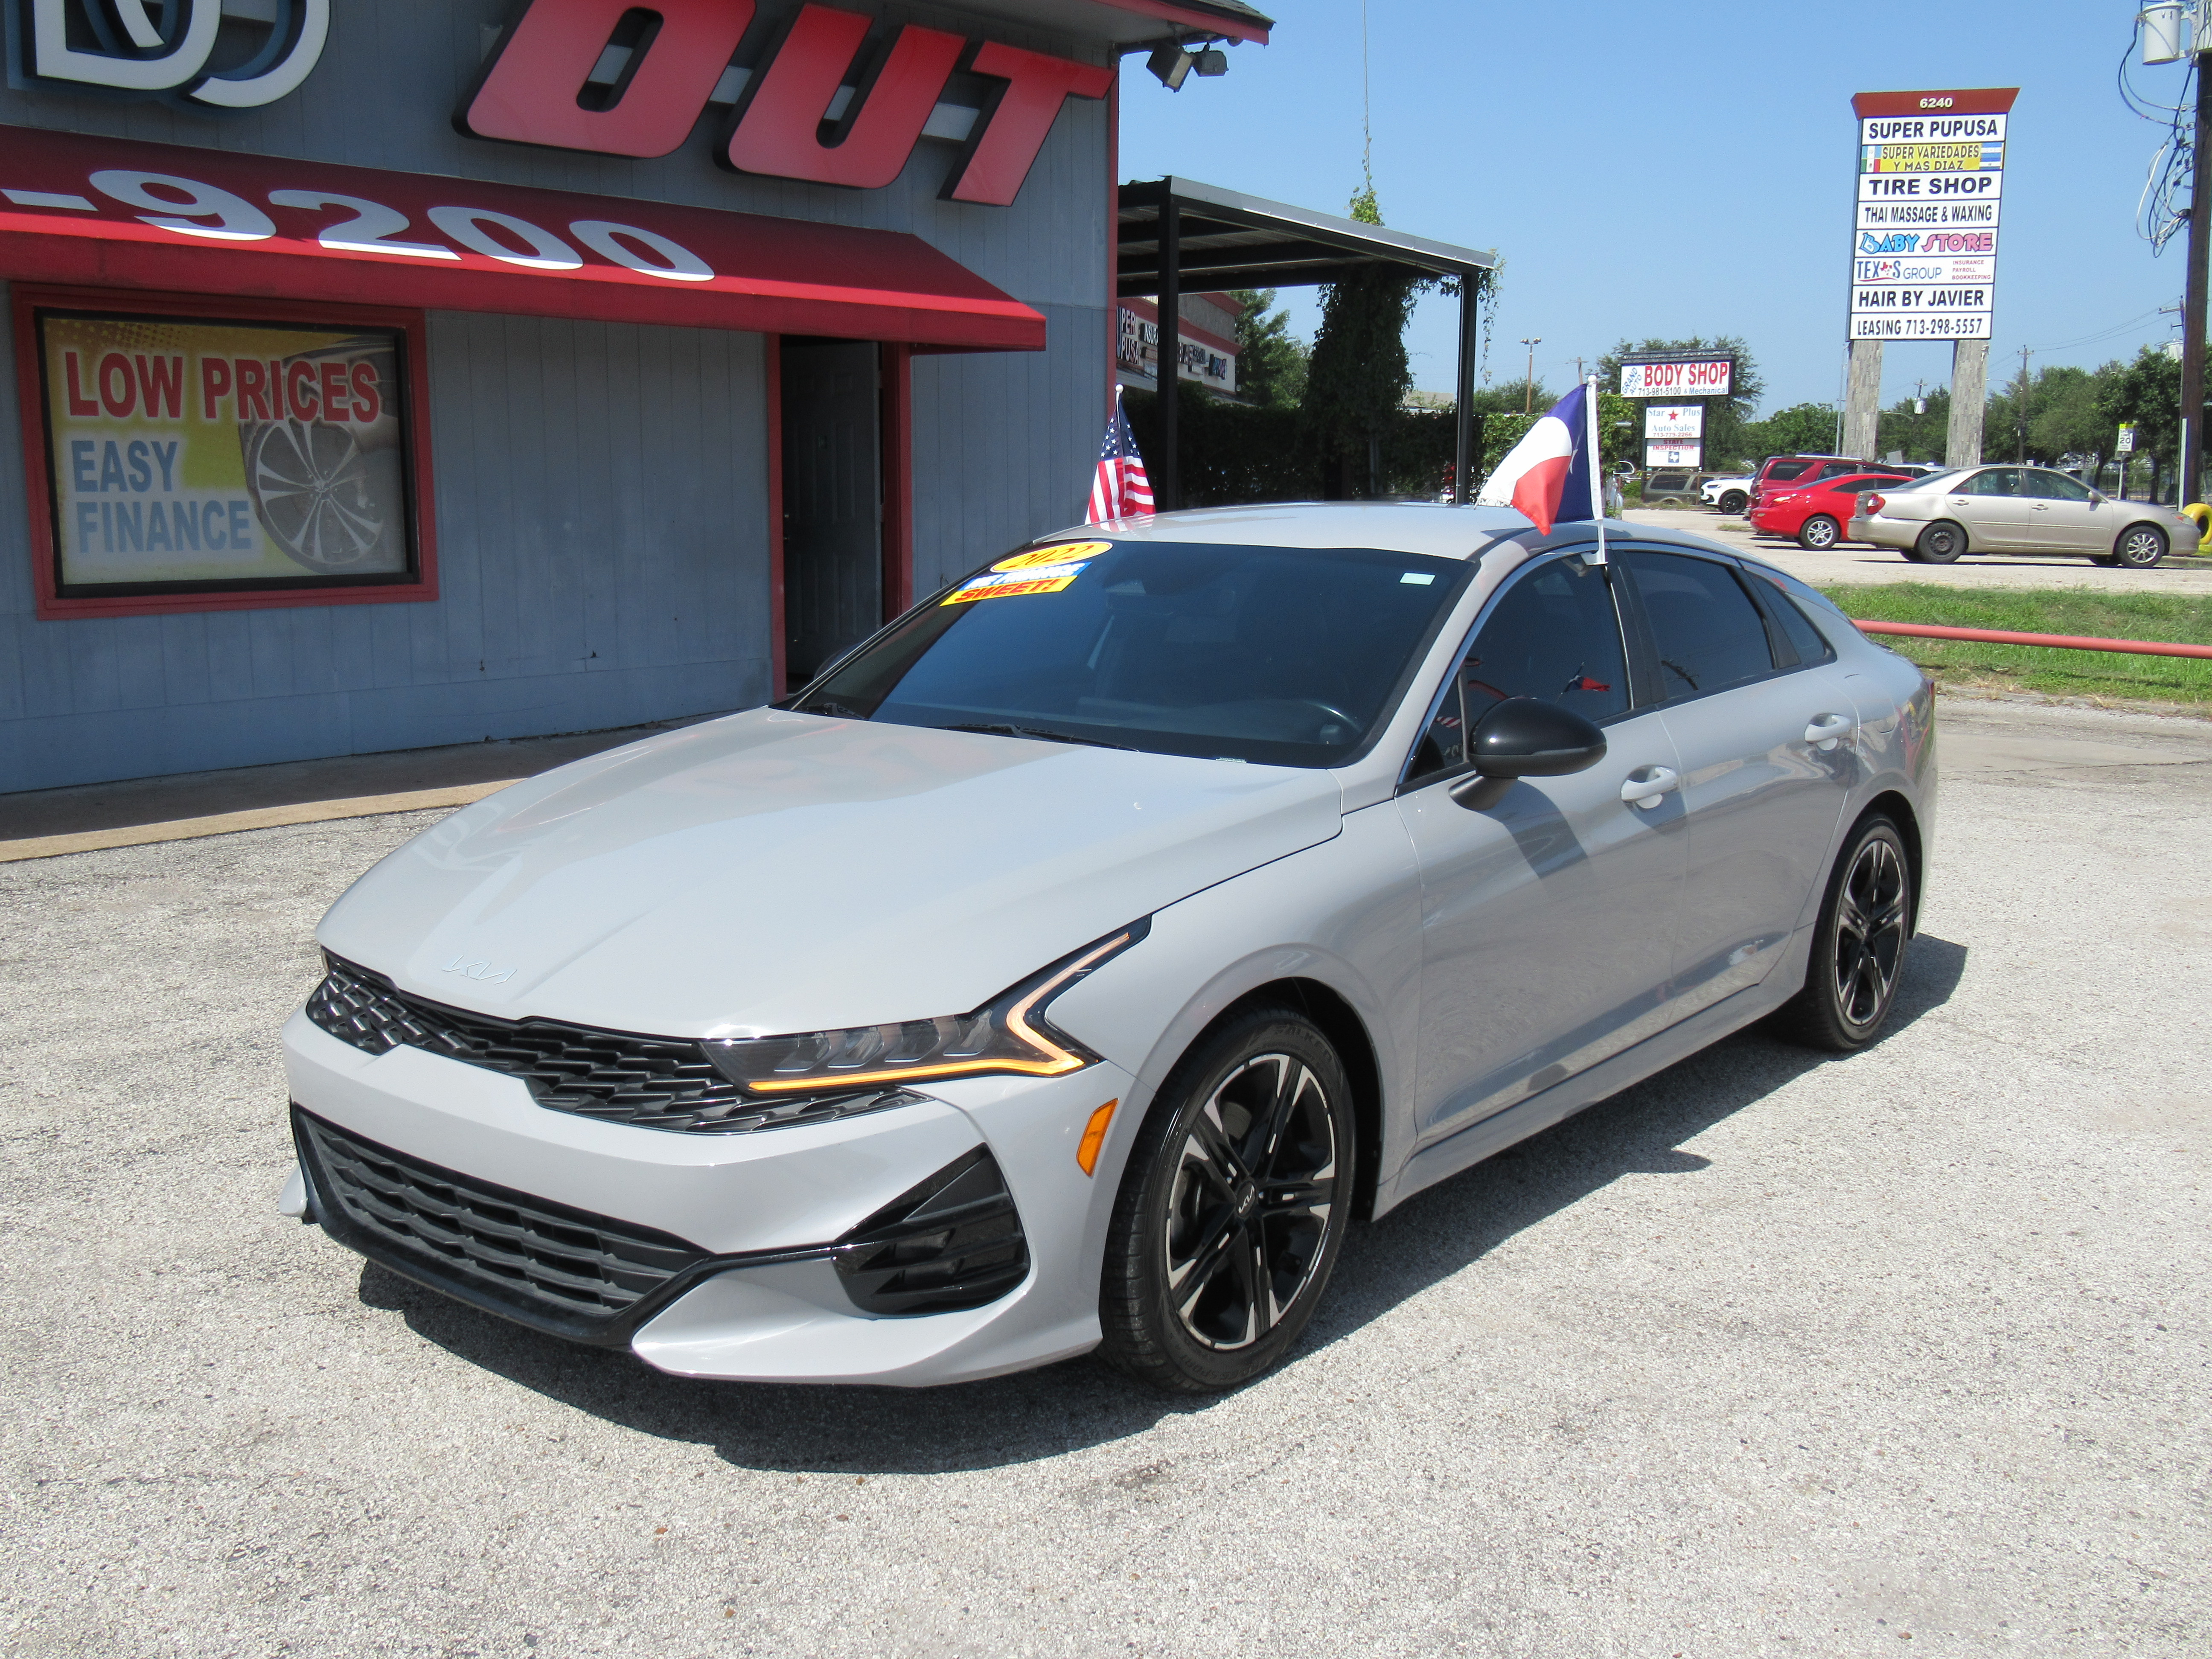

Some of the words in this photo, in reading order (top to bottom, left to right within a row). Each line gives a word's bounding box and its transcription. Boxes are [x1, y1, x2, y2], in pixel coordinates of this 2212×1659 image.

[1919, 97, 1953, 109] 6240
[1869, 121, 1924, 139] SUPER
[1929, 119, 1998, 138] PUPUSA
[1882, 146, 1914, 160] SUPER
[1918, 145, 1980, 159] VARIEDADES
[1893, 161, 1901, 171] Y
[1904, 161, 1930, 171] MAS
[1934, 160, 1964, 170] DIAZ
[1869, 178, 1921, 195] TIRE
[1929, 177, 1992, 194] SHOP
[1865, 207, 1888, 223] THAI
[1891, 206, 1938, 223] MASSAGE
[1941, 206, 1948, 222] &
[1951, 205, 1992, 222] WAXING
[1859, 232, 1920, 255] BABY
[1921, 233, 1994, 253] STORE
[1857, 260, 1901, 279] TEXS
[1903, 267, 1942, 279] GROUP
[1859, 291, 1897, 307] HAIR
[1902, 290, 1924, 307] BY
[1927, 290, 1985, 306] JAVIER
[1857, 319, 1902, 335] LEASING
[1906, 318, 1983, 335] 713-298-5557
[1622, 367, 1638, 394] GRAND
[1644, 364, 1684, 387] BODY
[1688, 362, 1728, 385] SHOP
[65, 351, 183, 419] LOW
[201, 356, 379, 423] PRICES
[1630, 374, 1642, 396] AUTO
[1638, 386, 1682, 396] 713-981-5100
[1689, 386, 1728, 395] Mechanical
[1647, 408, 1666, 417] Star
[1682, 407, 1701, 416] Plus
[1674, 424, 1696, 432] Sales
[71, 439, 178, 493] EASY
[76, 499, 253, 554] FINANCE
[1004, 544, 1095, 570] 2022
[954, 579, 1062, 603] SWEET!
